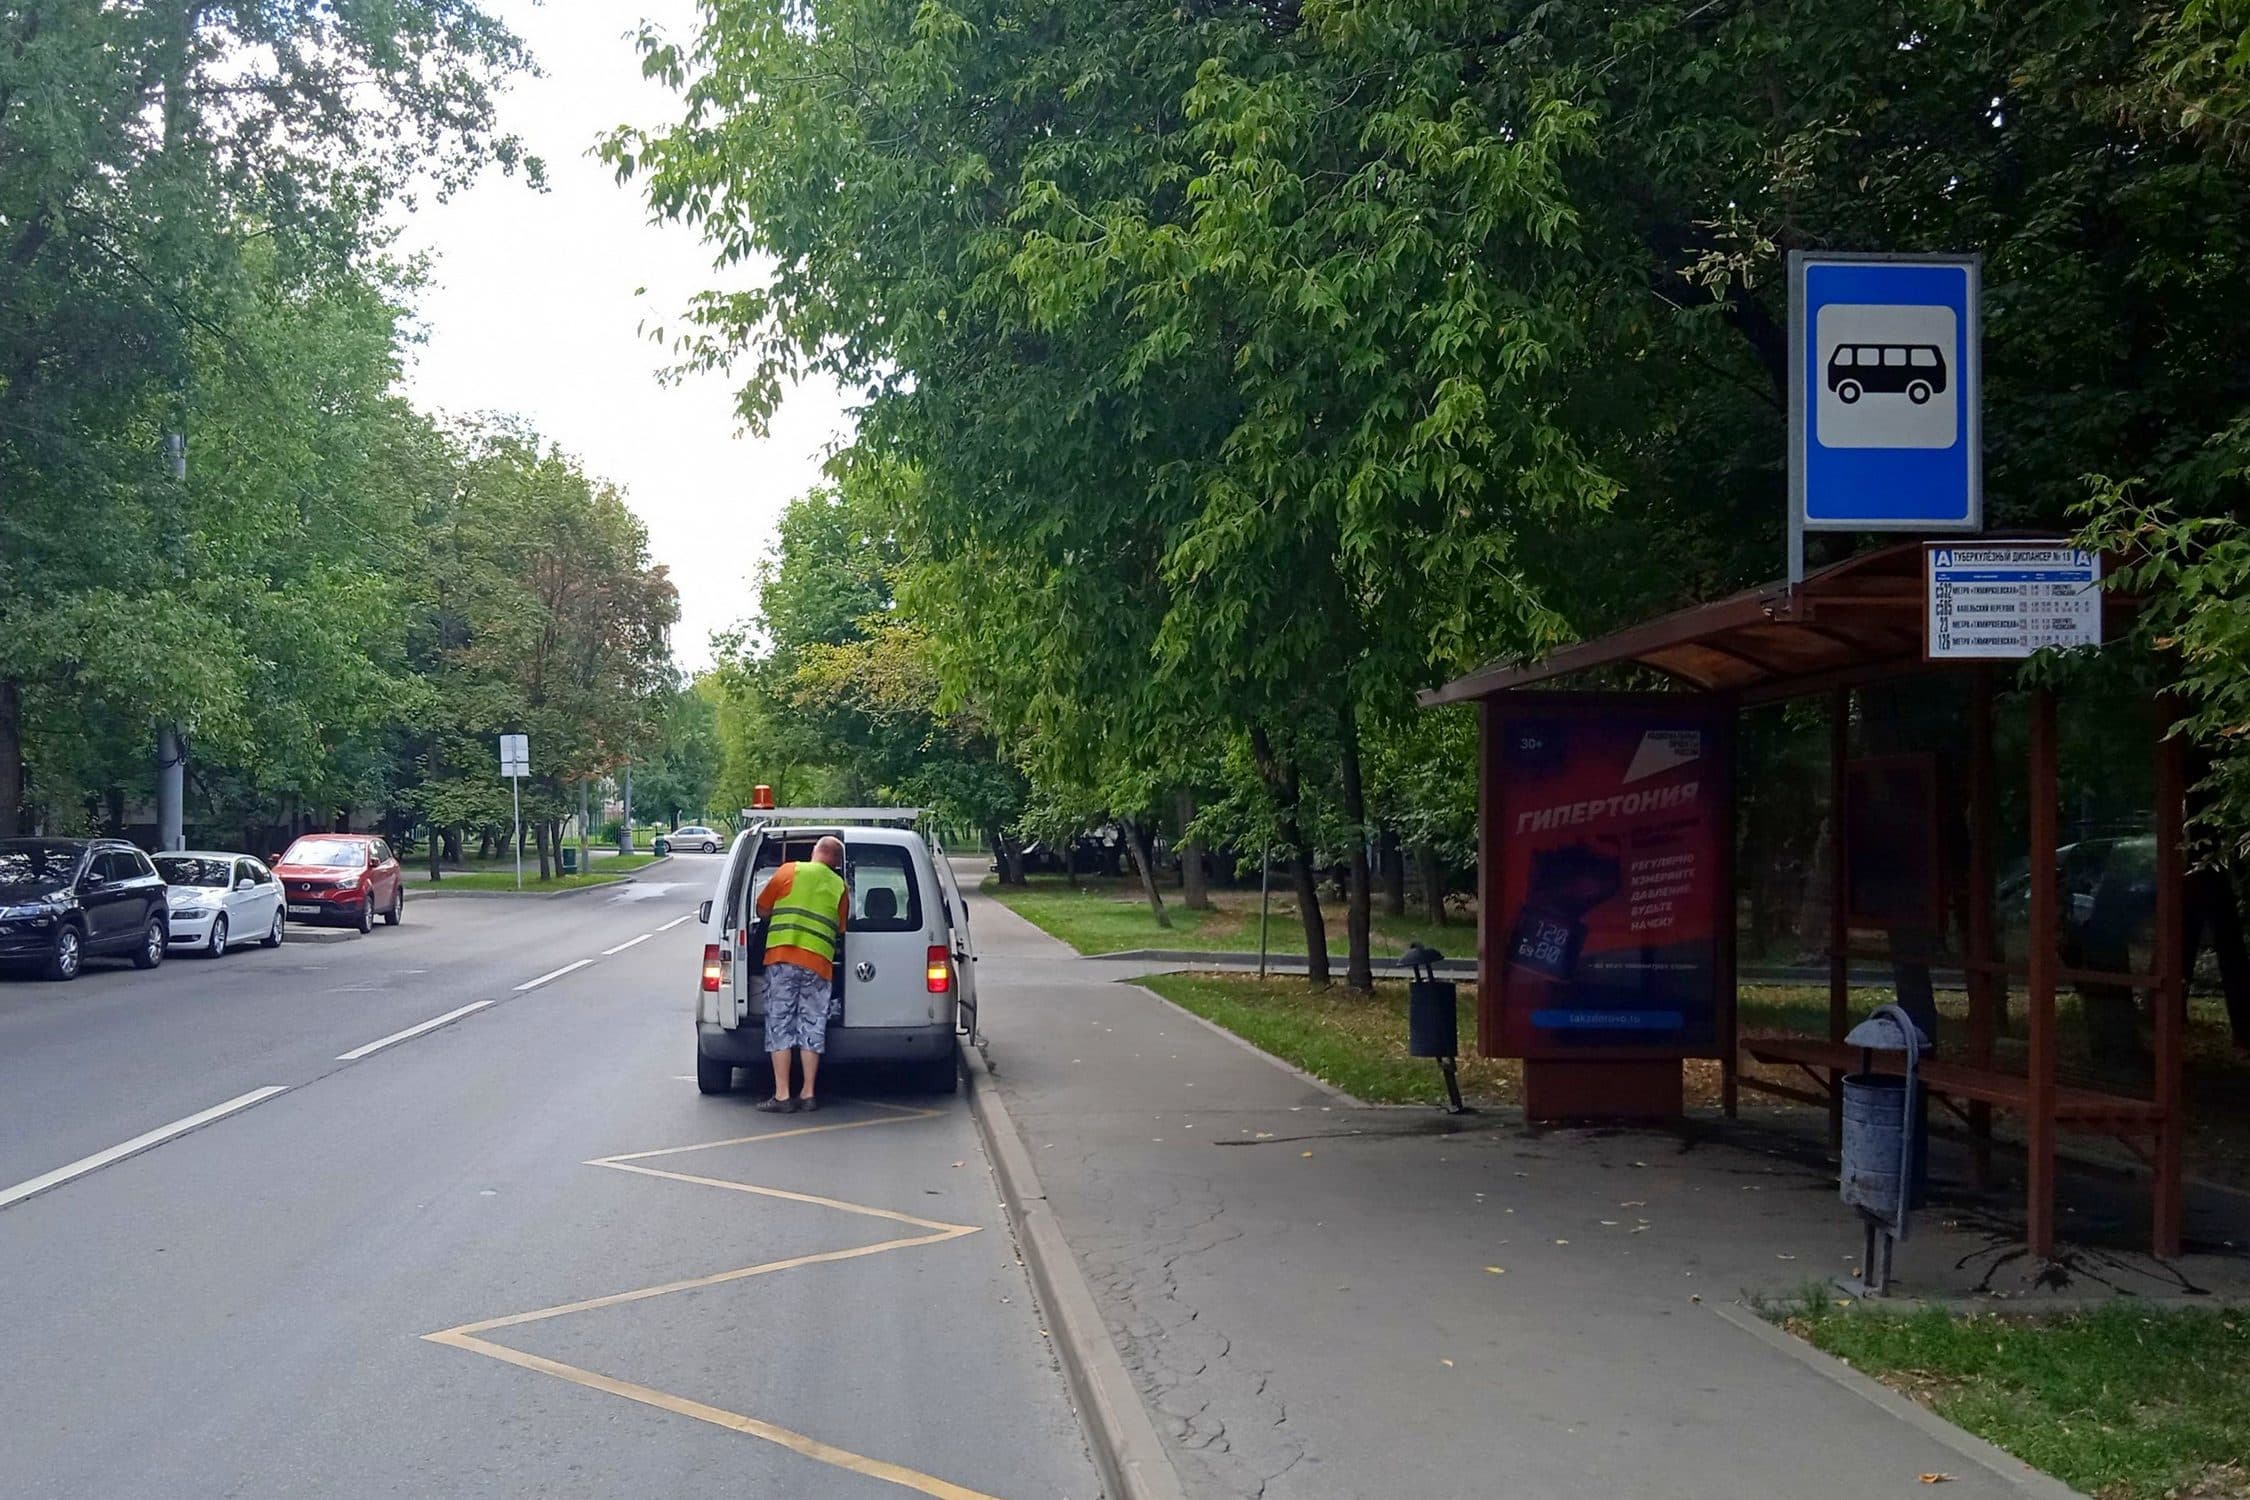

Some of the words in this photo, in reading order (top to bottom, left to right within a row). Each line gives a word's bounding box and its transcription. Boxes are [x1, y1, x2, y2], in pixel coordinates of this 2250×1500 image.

[1954, 551, 2011, 562] ТУБЕРКУЛЁЗНЫЙ
[2012, 551, 2052, 563] ДИСПАНСЕР
[1940, 616, 1948, 633] 23
[1938, 633, 1951, 650] 126
[1516, 781, 1700, 834] ГИПЕРТОНИЯ
[1631, 854, 1695, 871] РЕГУЛЯРНО
